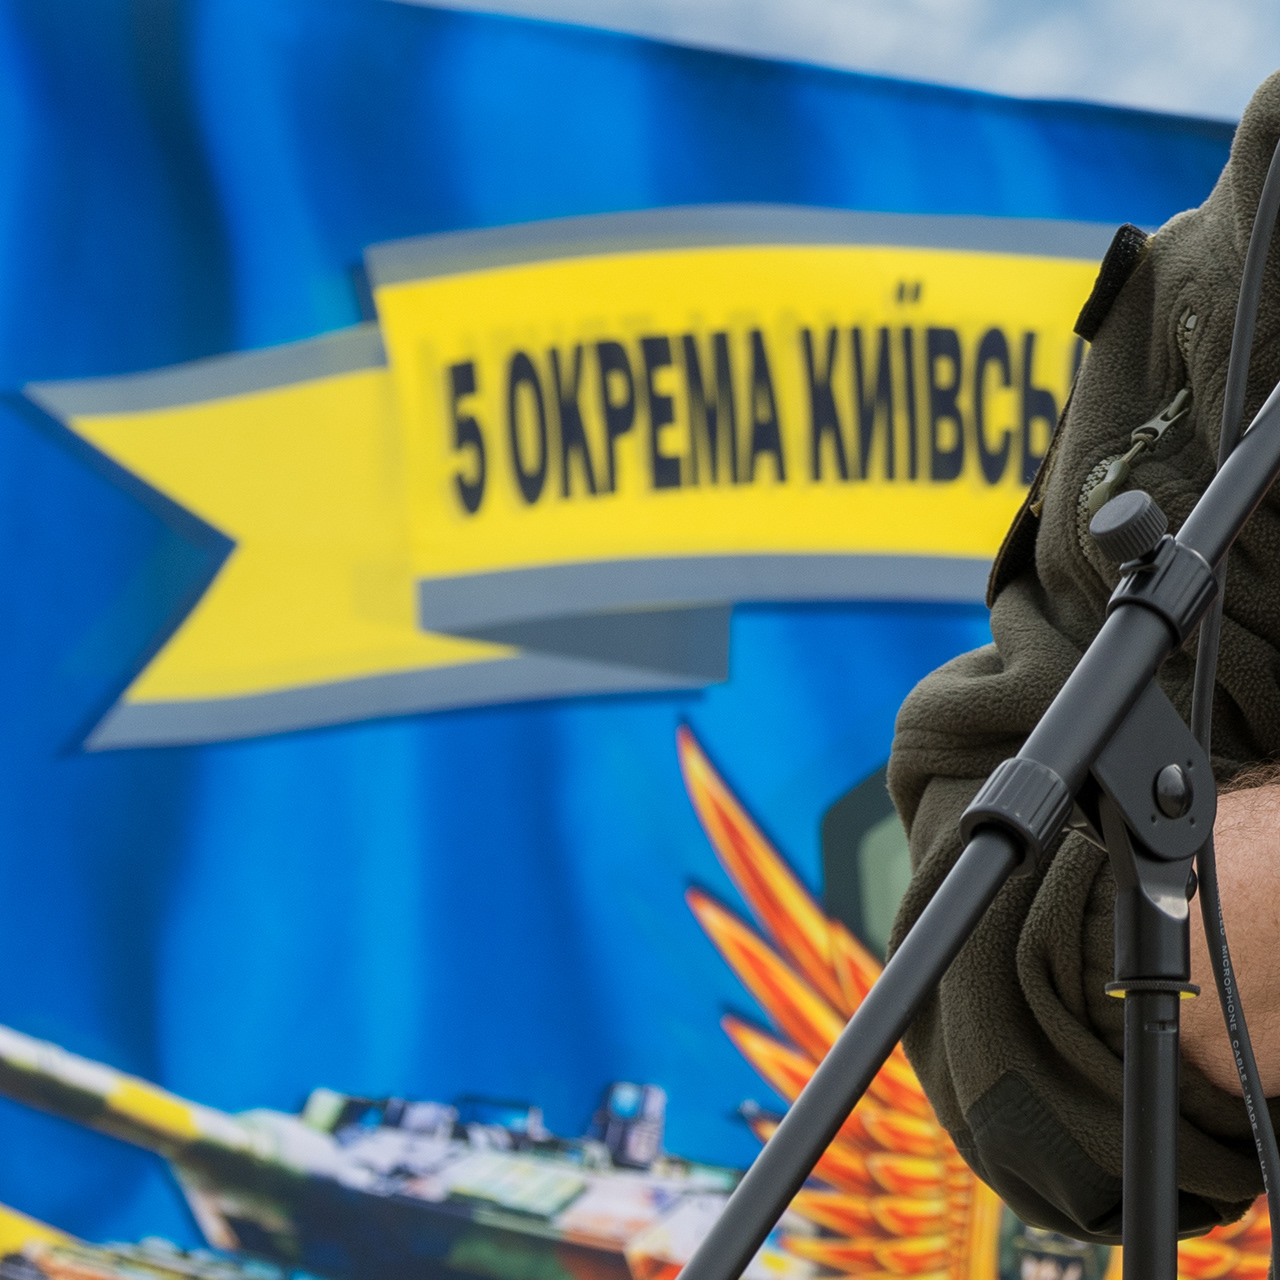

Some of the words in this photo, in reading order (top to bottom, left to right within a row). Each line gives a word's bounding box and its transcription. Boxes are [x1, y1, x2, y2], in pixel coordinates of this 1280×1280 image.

[446, 361, 486, 515] 5
[508, 326, 787, 504] ОКРЕМА
[1222, 945, 1237, 1032] MICROPHONE
[1232, 1040, 1247, 1081] CABLE
[1245, 1094, 1258, 1129] MADE
[1255, 1138, 1263, 1152] IN
